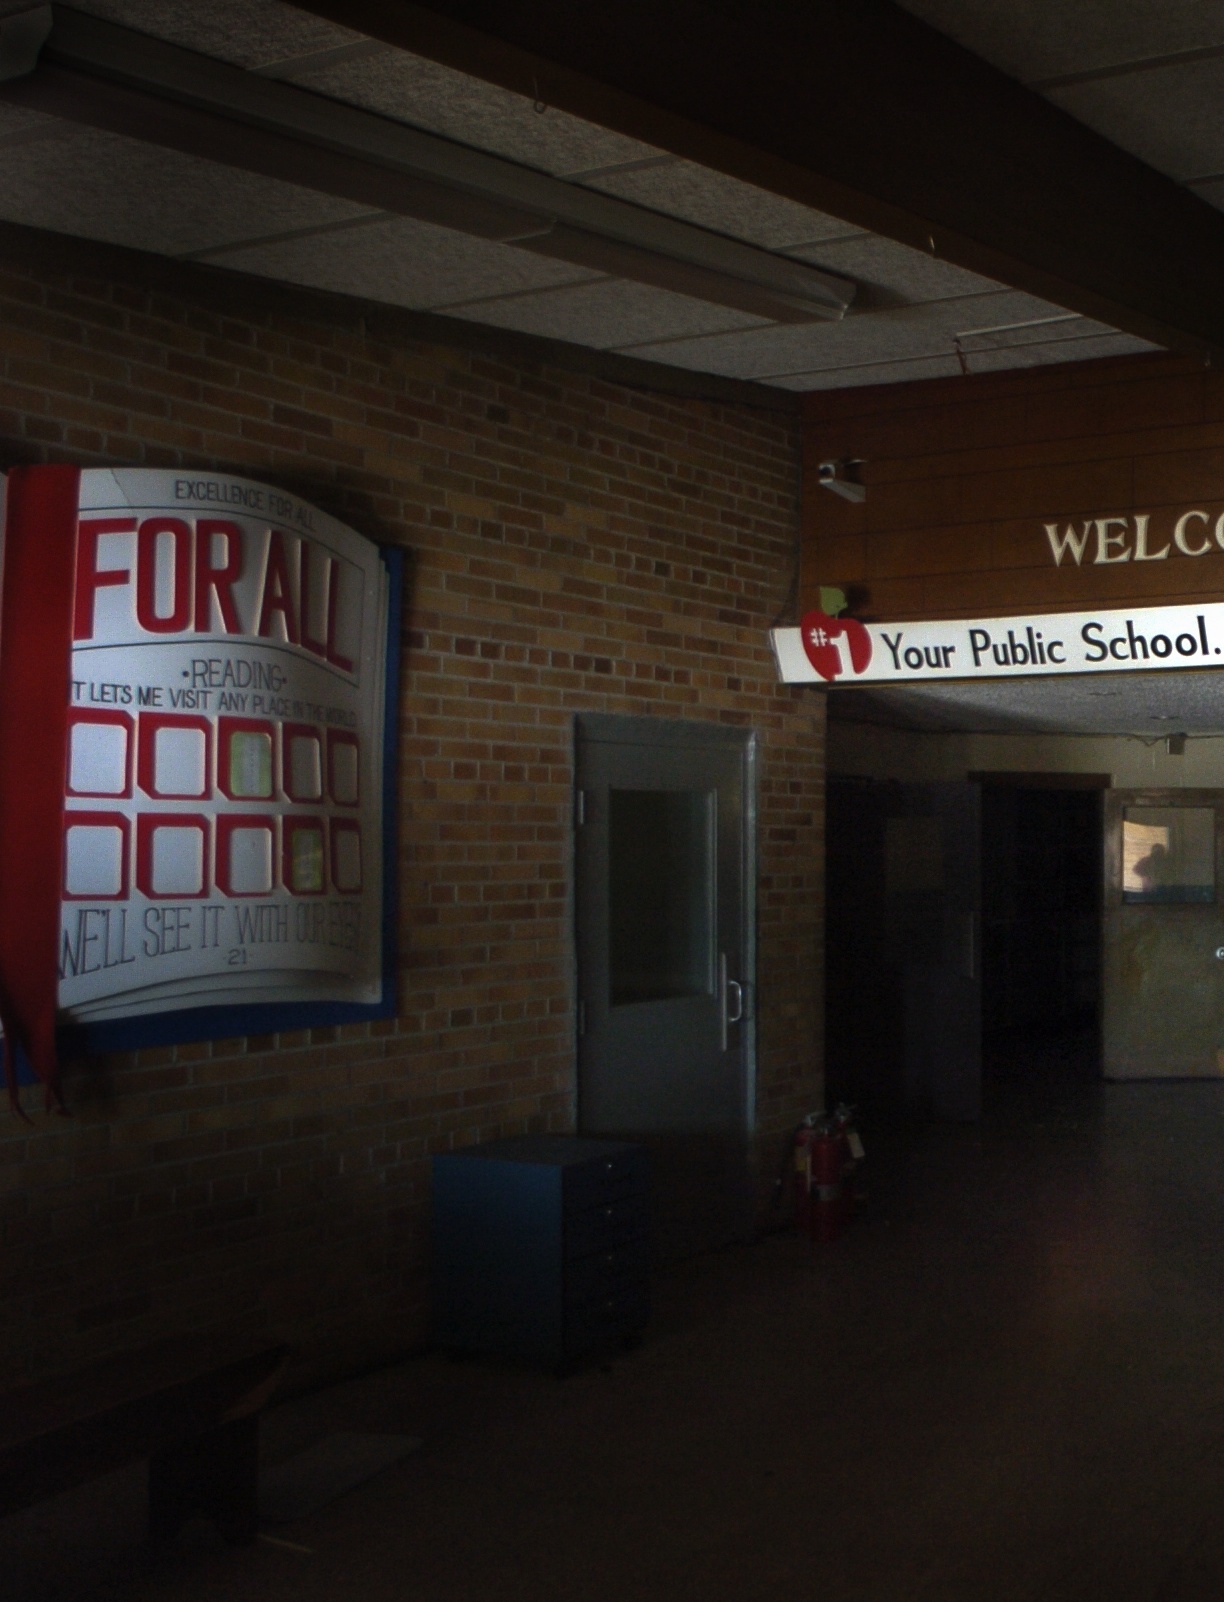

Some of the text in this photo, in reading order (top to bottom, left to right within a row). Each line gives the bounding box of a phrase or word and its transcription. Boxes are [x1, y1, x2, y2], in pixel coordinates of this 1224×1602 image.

[175, 480, 264, 511] EXCELLENCE
[268, 493, 293, 519] FOR
[73, 517, 354, 674] FOR ALL
[881, 631, 957, 671] Your
[970, 626, 1067, 668] Public
[190, 657, 284, 692] READING
[138, 686, 164, 707] ME
[168, 687, 213, 710] VISIT
[218, 691, 249, 712] ANY
[143, 907, 192, 958] SEE
[201, 905, 225, 949] IT
[234, 904, 290, 945] WITH
[227, 948, 248, 966] 21
